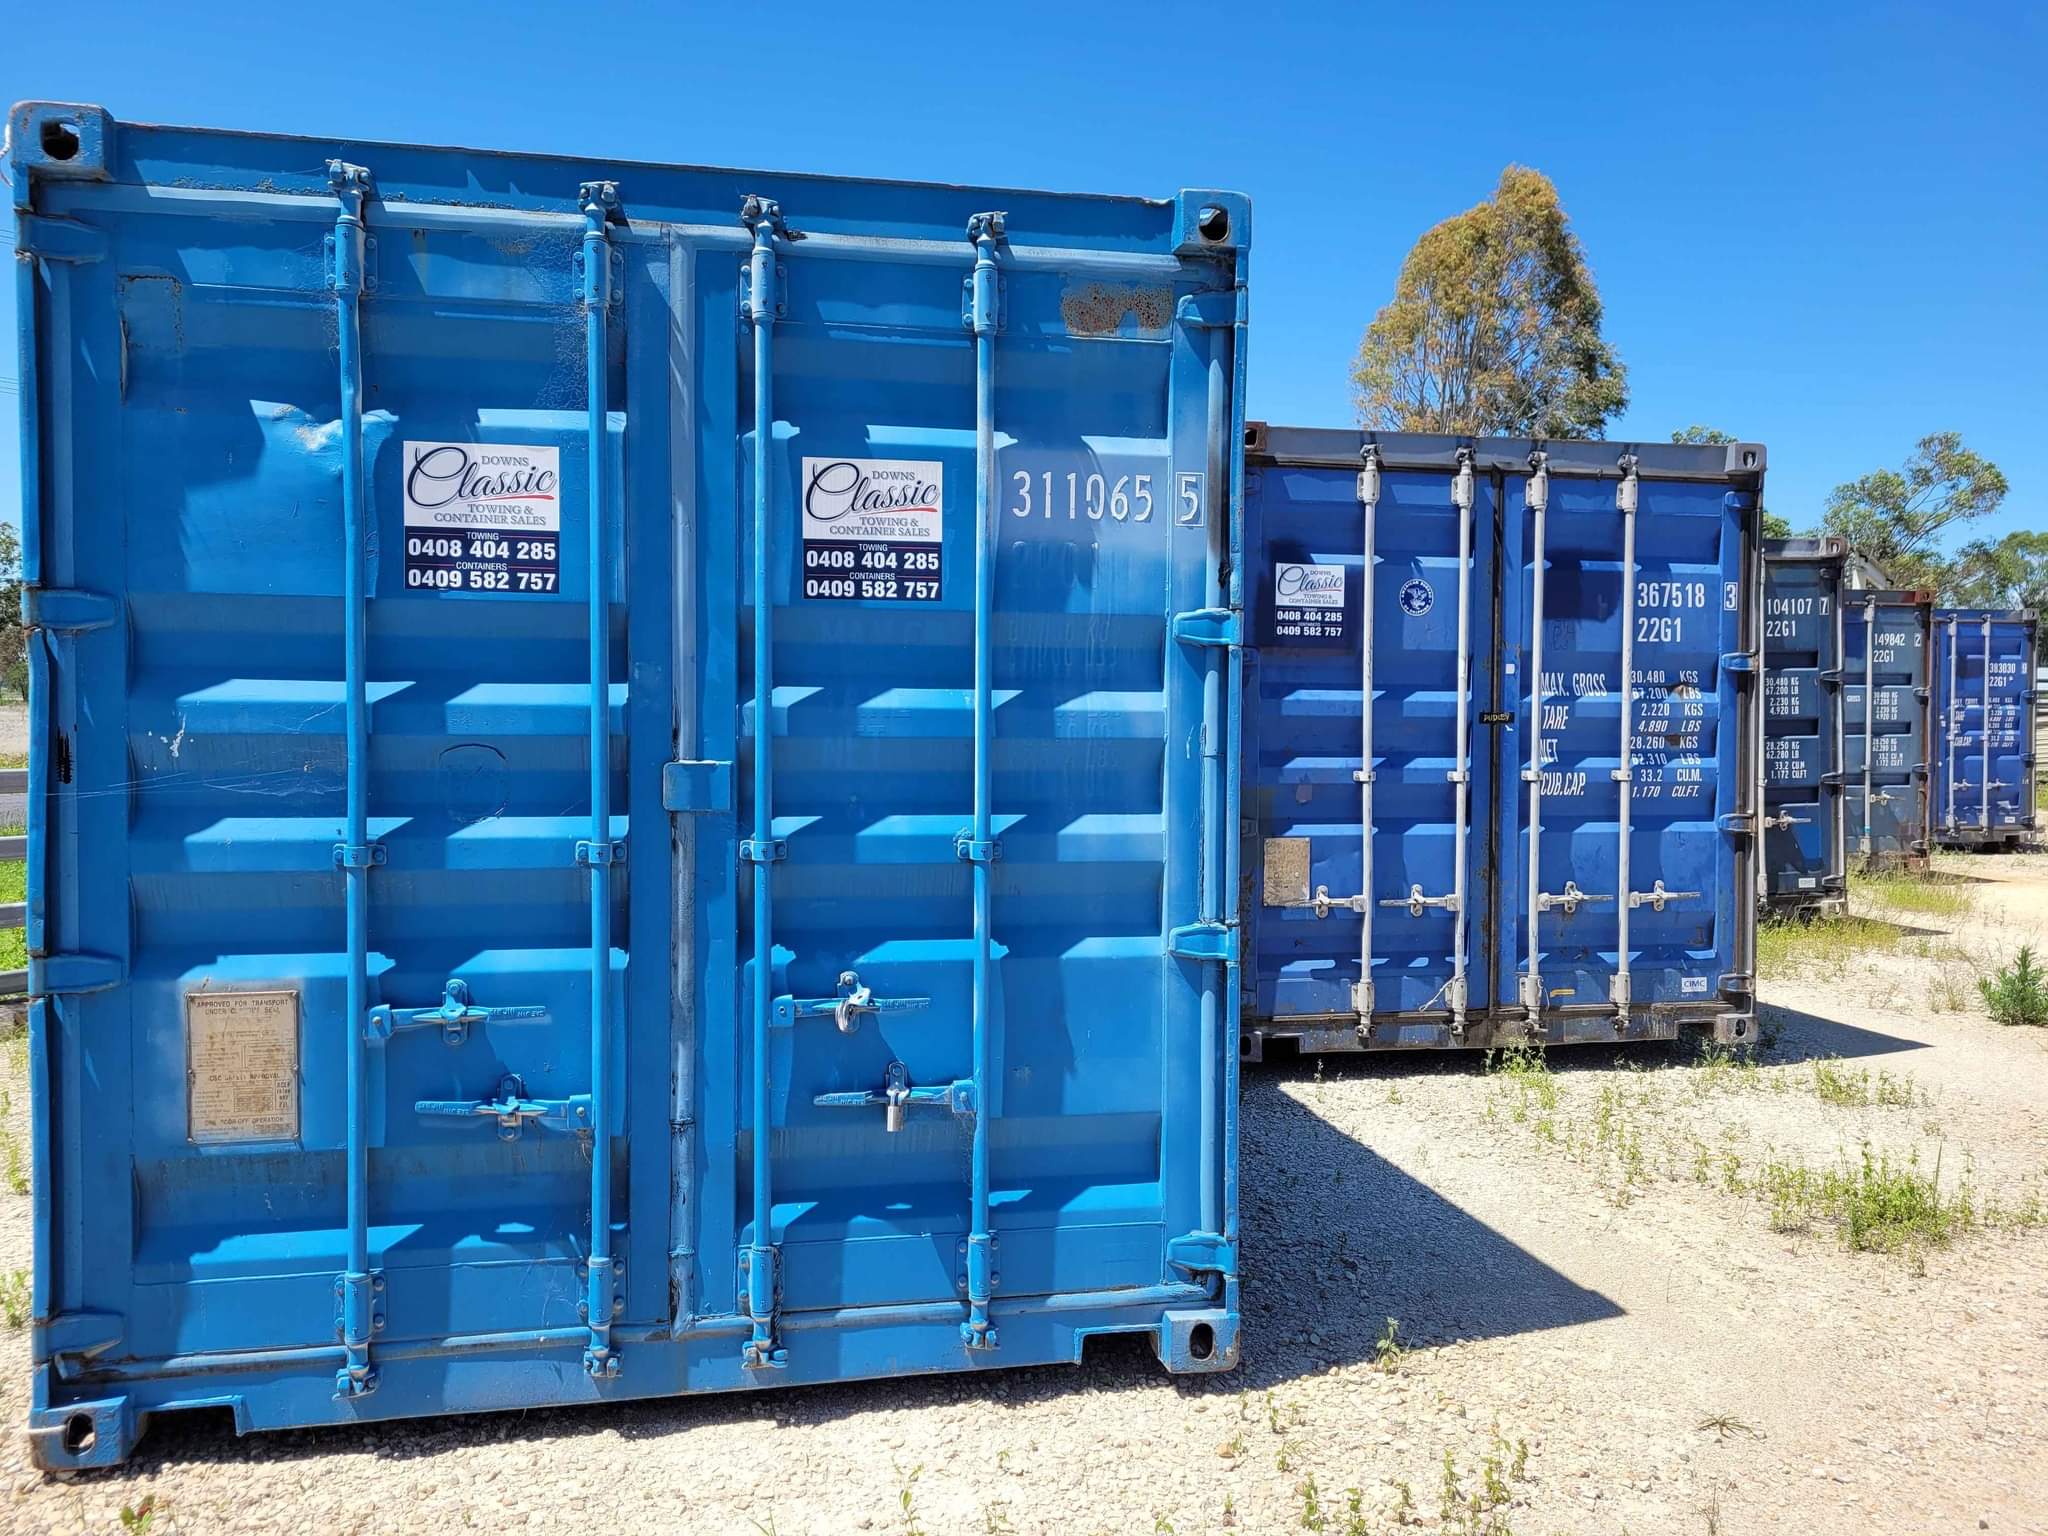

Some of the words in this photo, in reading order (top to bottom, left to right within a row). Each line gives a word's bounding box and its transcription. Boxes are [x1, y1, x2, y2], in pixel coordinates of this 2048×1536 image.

[481, 455, 529, 466] DOWNS
[407, 446, 557, 509] Classic
[872, 470, 915, 481] DOWNS
[805, 462, 940, 522] Classic
[1012, 470, 1153, 522] 311065
[1180, 475, 1199, 522] 5
[468, 504, 522, 514] TOWING
[524, 505, 534, 515] &
[434, 512, 509, 524] CONTAINER
[510, 515, 546, 526] SALES
[859, 516, 908, 527] TOWING
[910, 518, 919, 527] &
[466, 532, 499, 540] TOWING
[829, 525, 897, 536] CONTAINER
[898, 527, 930, 537] SALES
[408, 538, 462, 557] 0408
[470, 541, 510, 559] 404
[517, 542, 556, 560] 285
[858, 543, 888, 551] TOWING
[456, 561, 508, 571] CONTAINERS
[806, 550, 855, 568] 0408
[861, 552, 898, 569] 404
[904, 553, 939, 570] 285
[408, 569, 462, 587] 0409
[470, 571, 510, 589] 582
[517, 573, 556, 590] 757
[849, 572, 896, 580] CONTAINERS
[1277, 565, 1343, 596] Classic
[806, 579, 855, 597] 0409
[862, 581, 898, 598] 582
[904, 582, 939, 598] 757
[1638, 582, 1705, 608] 367518
[1726, 584, 1736, 609] 3
[1767, 598, 1813, 615] 104107
[1821, 598, 1828, 615] 7
[1277, 611, 1301, 621] 0408
[1304, 612, 1322, 621] 404
[1325, 612, 1343, 622] 285
[1276, 626, 1301, 635] 0409
[1304, 626, 1321, 636] 582
[1325, 627, 1342, 637] 757
[1637, 617, 1681, 642] 22G1
[1766, 621, 1796, 638] 22G1
[1874, 633, 1906, 646] 149842
[1915, 633, 1921, 647] 2
[1873, 650, 1894, 663] 22G1
[1680, 670, 1698, 683] KGS
[1791, 677, 1799, 686] KG
[1989, 676, 2007, 687] 22G1
[1573, 673, 1607, 697] GROSS
[1791, 686, 1799, 694] LB
[1683, 688, 1702, 700] LBS
[1791, 697, 1800, 706] KG
[1641, 703, 1670, 716] 2.220
[1684, 703, 1703, 716] KGS
[1791, 706, 1799, 714] LB
[1542, 705, 1569, 730] TARE
[1681, 720, 1701, 732] LBS
[1630, 736, 1665, 749] 28.260
[1680, 736, 1698, 749] KGS
[1791, 741, 1800, 750] KG
[1681, 753, 1701, 765] LBS
[1791, 750, 1799, 759] LB
[1775, 762, 1789, 770] 33.2
[1640, 769, 1663, 782] 33.2
[1677, 769, 1702, 782] CU.M.
[1771, 770, 1789, 779] 1.172
[1632, 786, 1660, 798] 1.170
